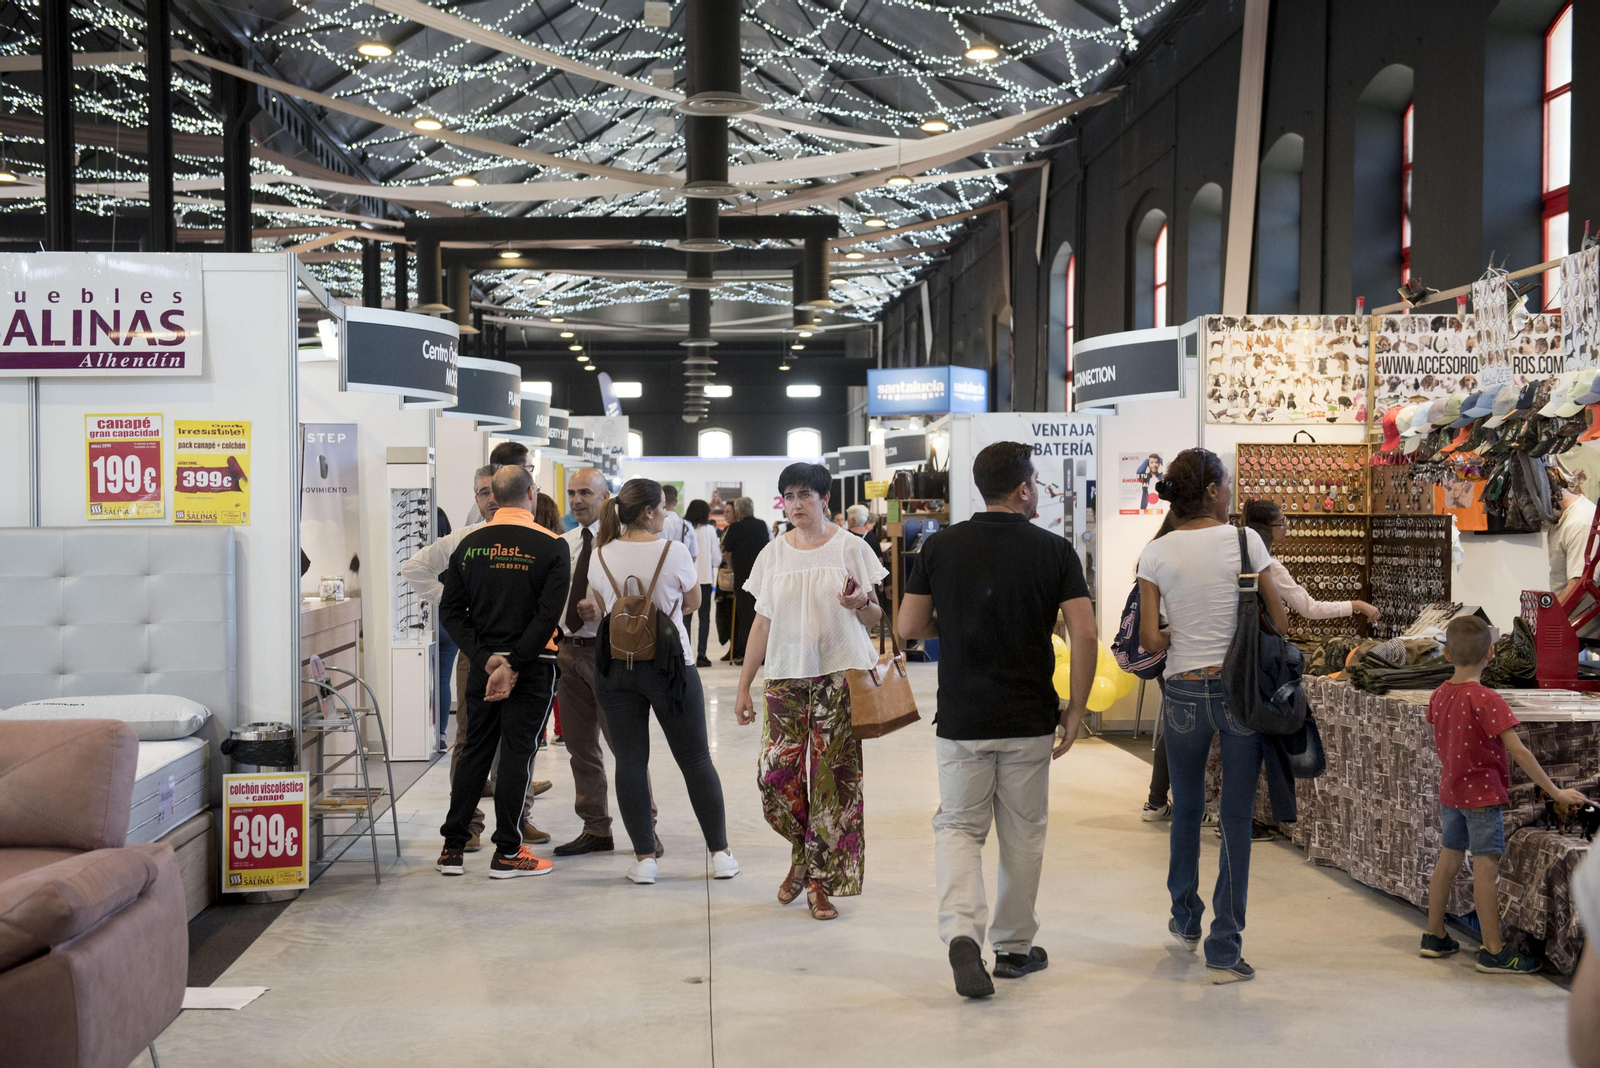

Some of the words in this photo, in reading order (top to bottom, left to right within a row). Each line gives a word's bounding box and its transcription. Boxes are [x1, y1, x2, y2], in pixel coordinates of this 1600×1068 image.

[0, 309, 186, 347] ALINAS
[422, 340, 449, 363] Centro
[78, 353, 181, 368] Alhendín
[1382, 355, 1480, 374] WWW.ACCESORIO
[877, 379, 945, 395] santalucía
[97, 417, 151, 430] canapé
[1032, 423, 1096, 437] VENTAJA
[89, 430, 110, 438] gran
[112, 429, 160, 438] capacidad
[307, 433, 347, 443] STEP
[177, 441, 193, 449] pack
[193, 441, 216, 450] canapé
[221, 441, 246, 450] colchón
[1034, 439, 1094, 456] BATERÍA
[93, 454, 157, 494] 199€
[182, 470, 232, 488] 399€
[302, 486, 348, 494] OVIMIENTO
[772, 496, 786, 510] 2
[463, 543, 523, 561] Arruplast
[230, 782, 260, 795] colchón
[260, 781, 304, 795] viscolástica
[252, 794, 285, 802] canapé
[233, 814, 299, 860] 399€
[243, 878, 275, 886] SALINAS
